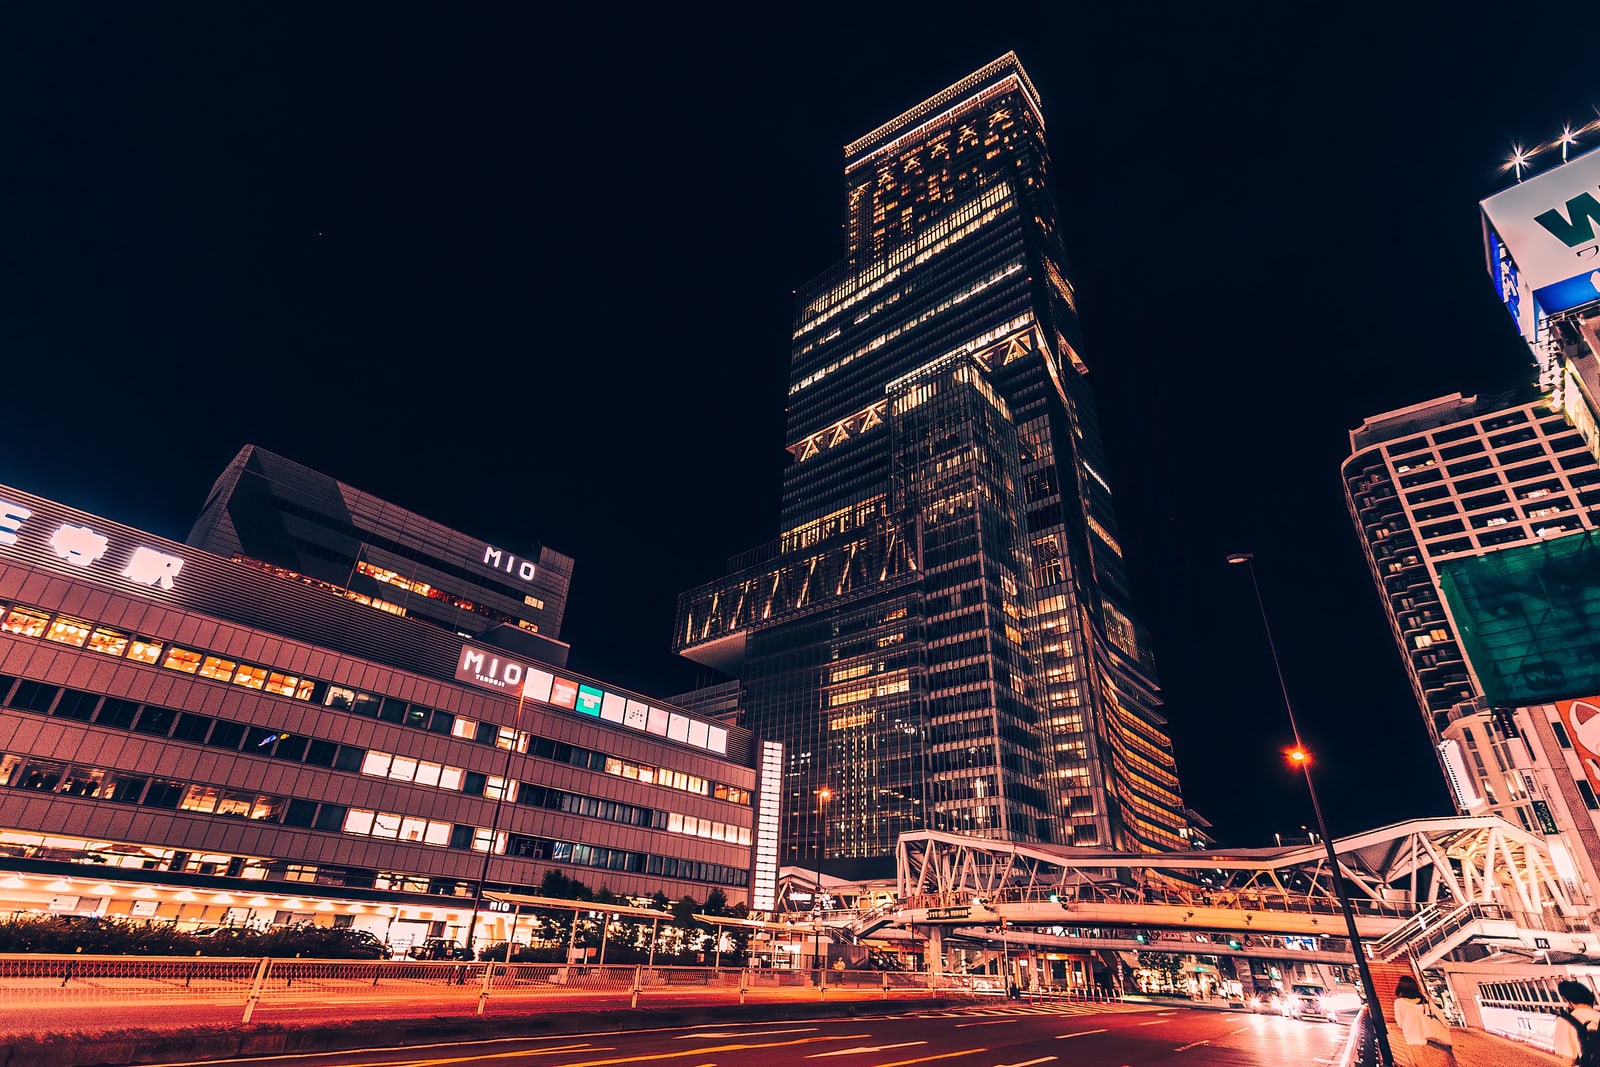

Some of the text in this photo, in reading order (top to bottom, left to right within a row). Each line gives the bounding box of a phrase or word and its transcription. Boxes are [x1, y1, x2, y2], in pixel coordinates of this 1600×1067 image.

[483, 546, 535, 581] MIO
[463, 650, 522, 685] MIO
[489, 901, 510, 912] MIO
